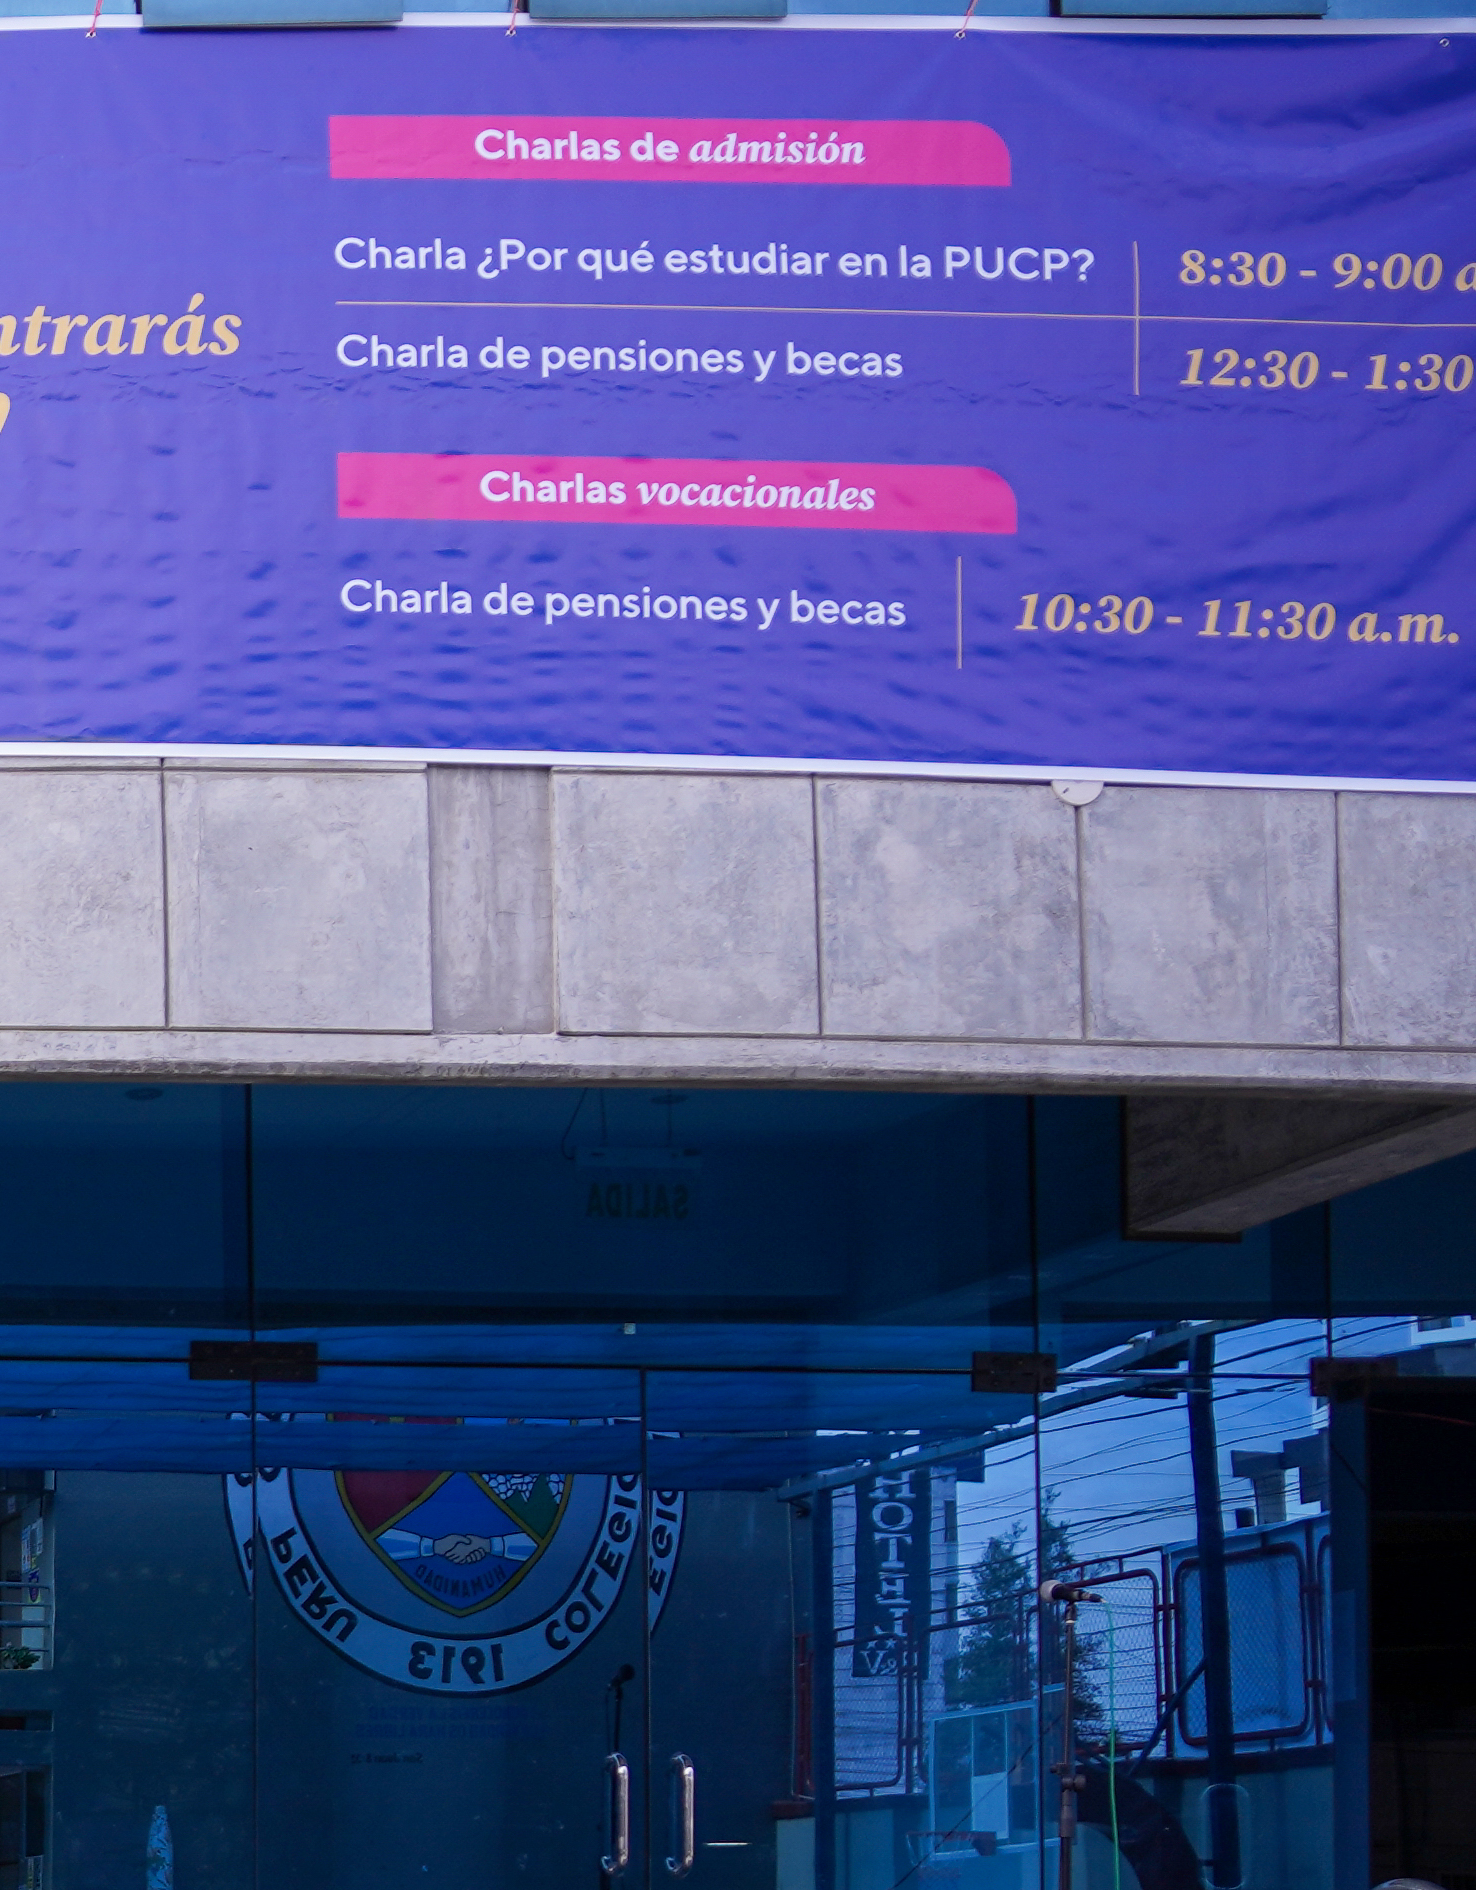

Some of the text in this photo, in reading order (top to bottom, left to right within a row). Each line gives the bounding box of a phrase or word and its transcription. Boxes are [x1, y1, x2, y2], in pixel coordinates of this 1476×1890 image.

[475, 129, 865, 164] Charlas de admisión
[335, 238, 1094, 281] Charla ¿Por qué estudiar en la PUCP?
[1180, 250, 1286, 286] 8:30
[1333, 253, 1442, 290] 9:00
[337, 335, 902, 382] Charla de pensiones y becas
[1180, 349, 1319, 389] 12:30
[1365, 354, 1473, 391] 1:30
[480, 471, 875, 511] Charlas vocacionales
[341, 579, 906, 630] Charla de pensiones y becas
[1014, 593, 1153, 634] 10:30
[1198, 600, 1335, 640] 11:30
[1348, 613, 1459, 643] a.m.
